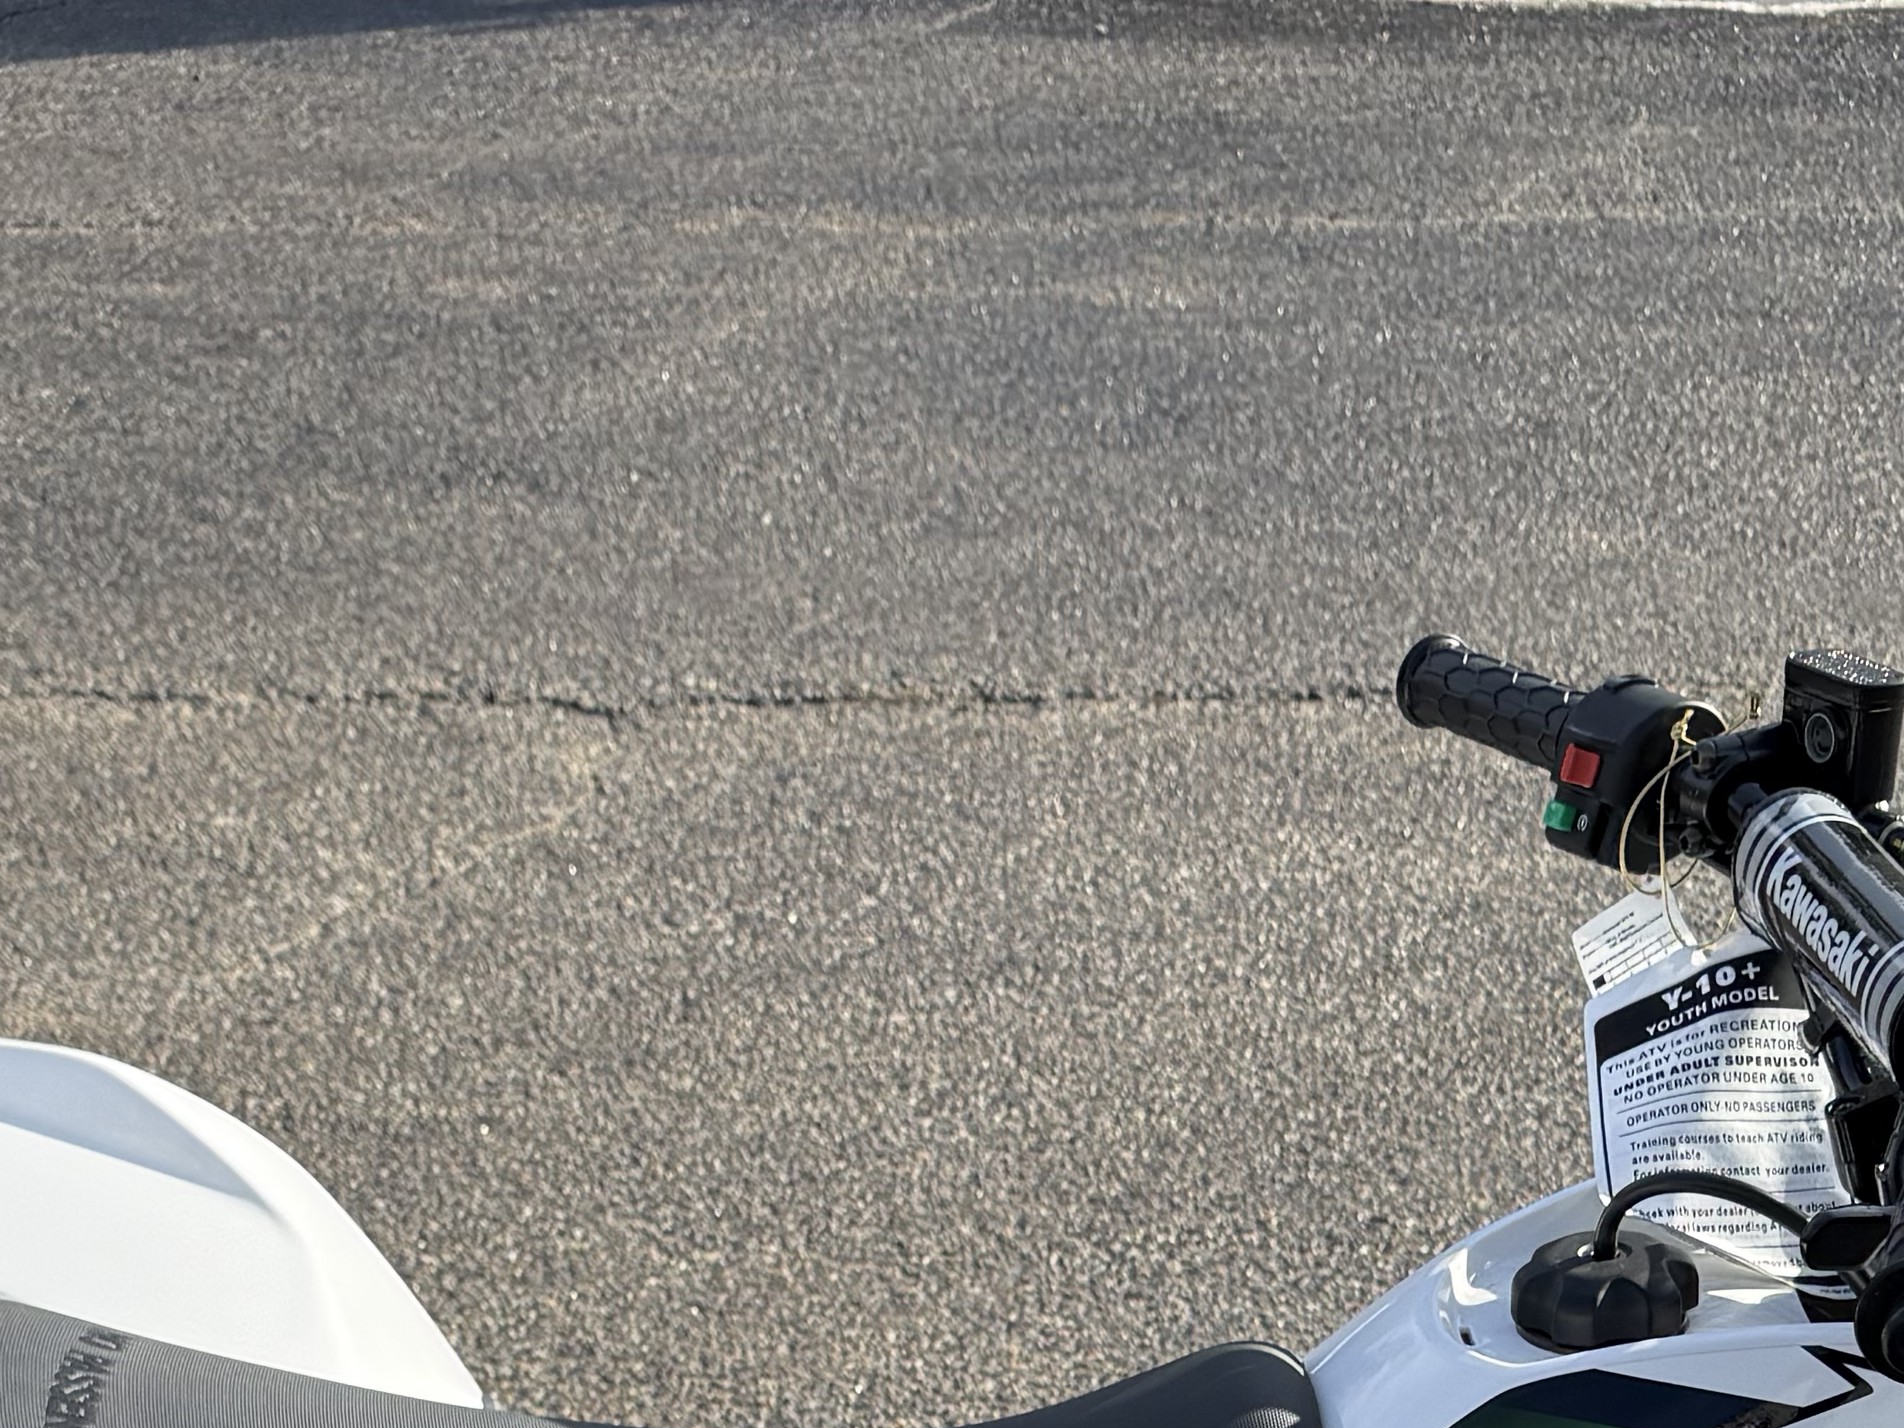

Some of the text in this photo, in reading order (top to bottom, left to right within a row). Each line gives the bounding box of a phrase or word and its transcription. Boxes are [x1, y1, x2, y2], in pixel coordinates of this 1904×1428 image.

[1765, 845, 1880, 998] Kawasaki
[1645, 986, 1780, 1036] YOUTH MODEL
[1606, 1057, 1634, 1075] This
[1639, 1043, 1667, 1061] ATV
[1685, 1029, 1706, 1045] for
[1626, 1063, 1651, 1079] USE
[1655, 1054, 1671, 1068] BY
[1674, 1040, 1725, 1058] YOUNG
[1613, 1069, 1665, 1096] UNDER
[1669, 1056, 1721, 1076] ADULT
[1623, 1072, 1815, 1105] NO OPERATOR UNDER AGE 10
[1626, 1102, 1688, 1127] OPERATOR
[1742, 1100, 1816, 1113] PASSENGERS
[1767, 1131, 1788, 1143] ATV
